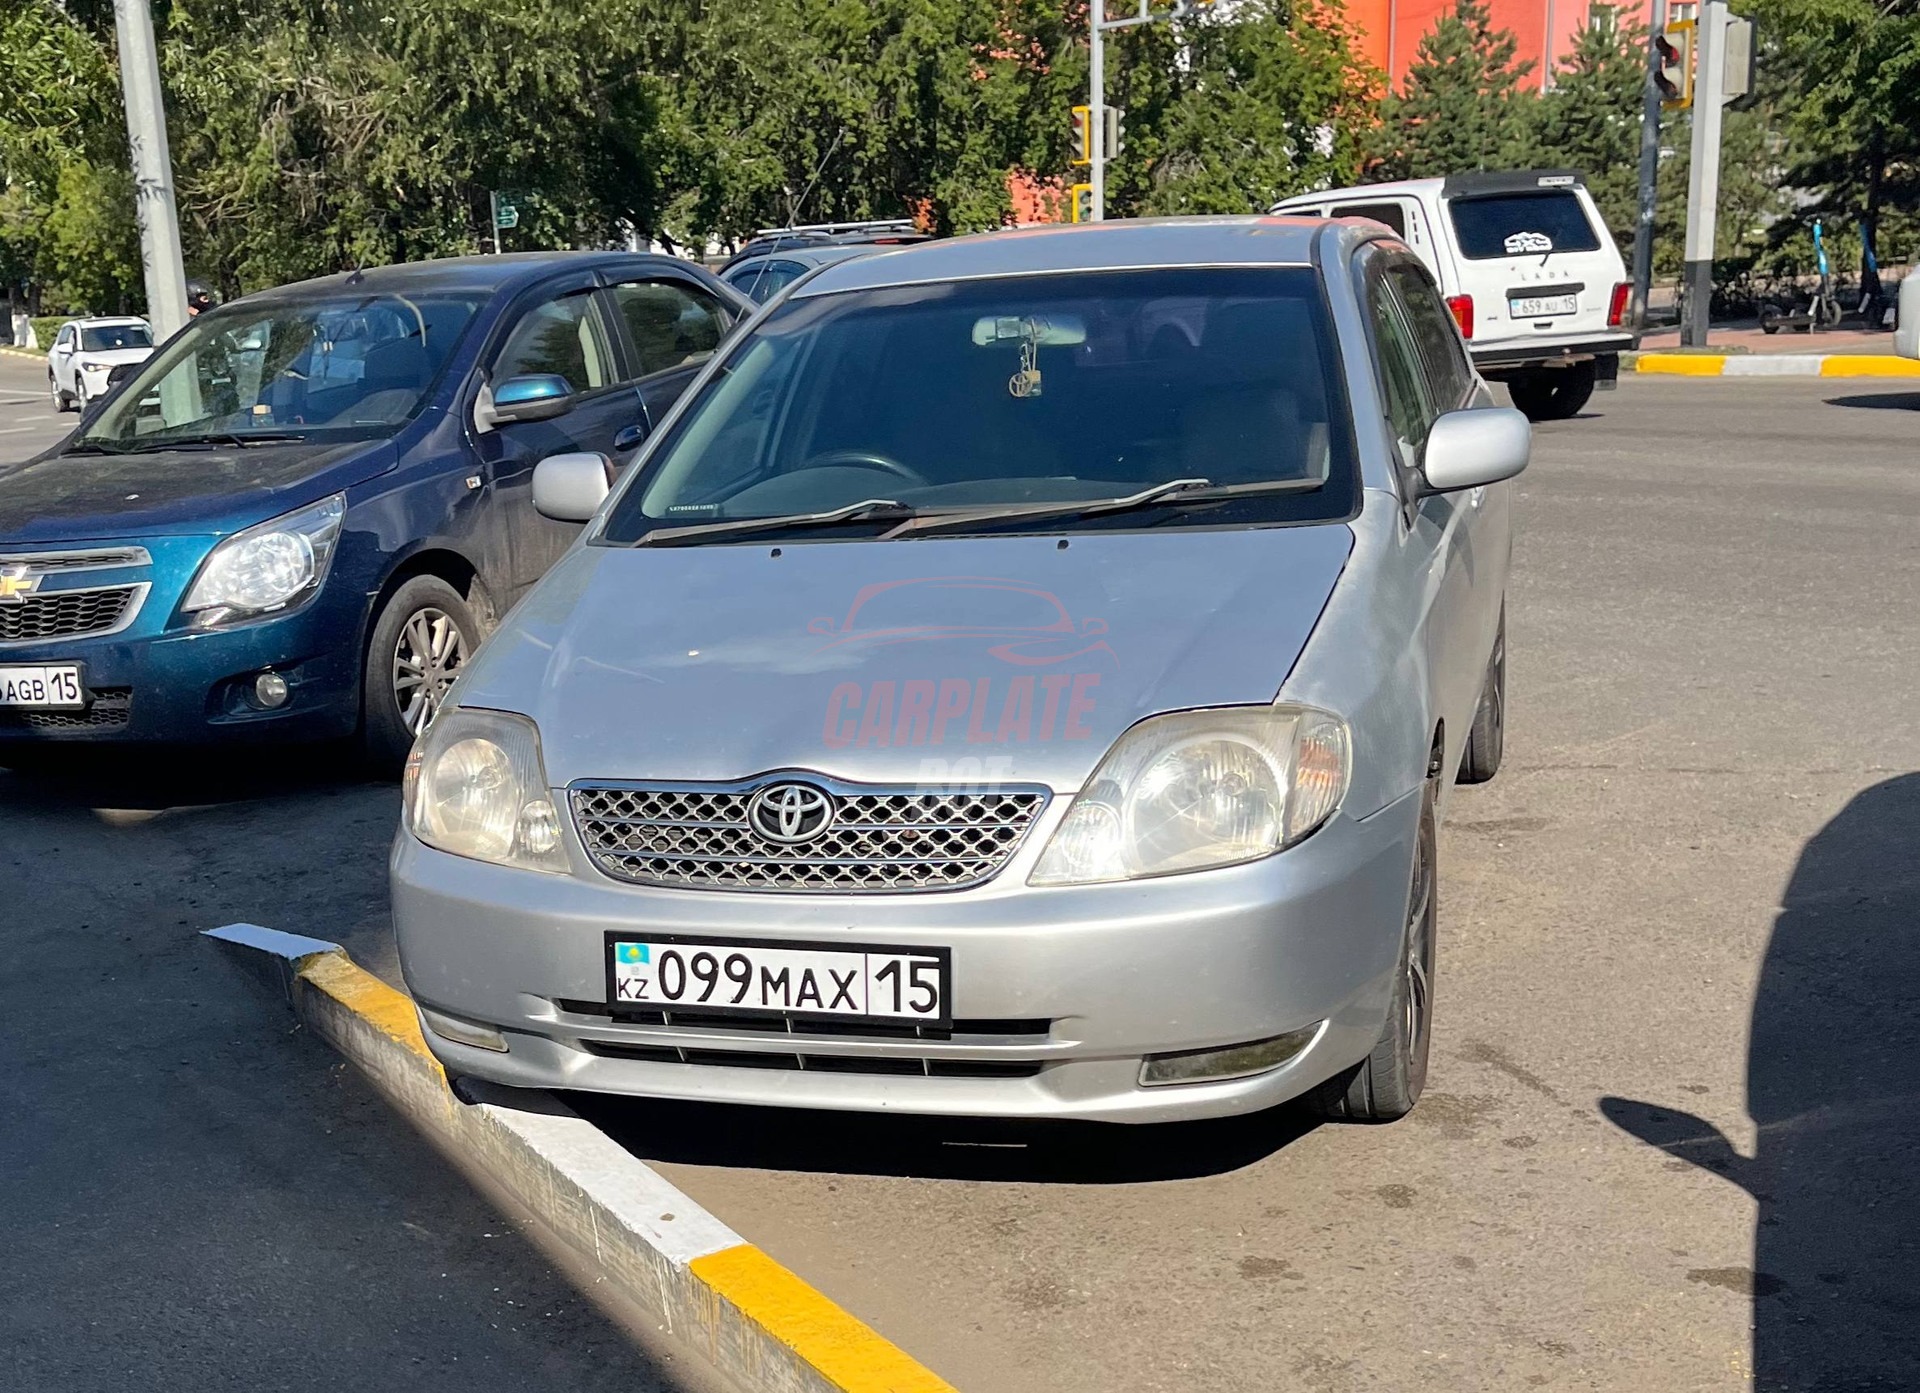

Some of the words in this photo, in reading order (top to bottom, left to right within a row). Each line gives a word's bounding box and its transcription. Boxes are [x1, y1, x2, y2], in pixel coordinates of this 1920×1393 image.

[1521, 270, 1569, 281] LADA
[1522, 300, 1541, 314] 659
[0, 679, 45, 701] AGB
[50, 672, 78, 701] 15
[617, 977, 650, 1000] KZ
[874, 959, 939, 1014] 15
